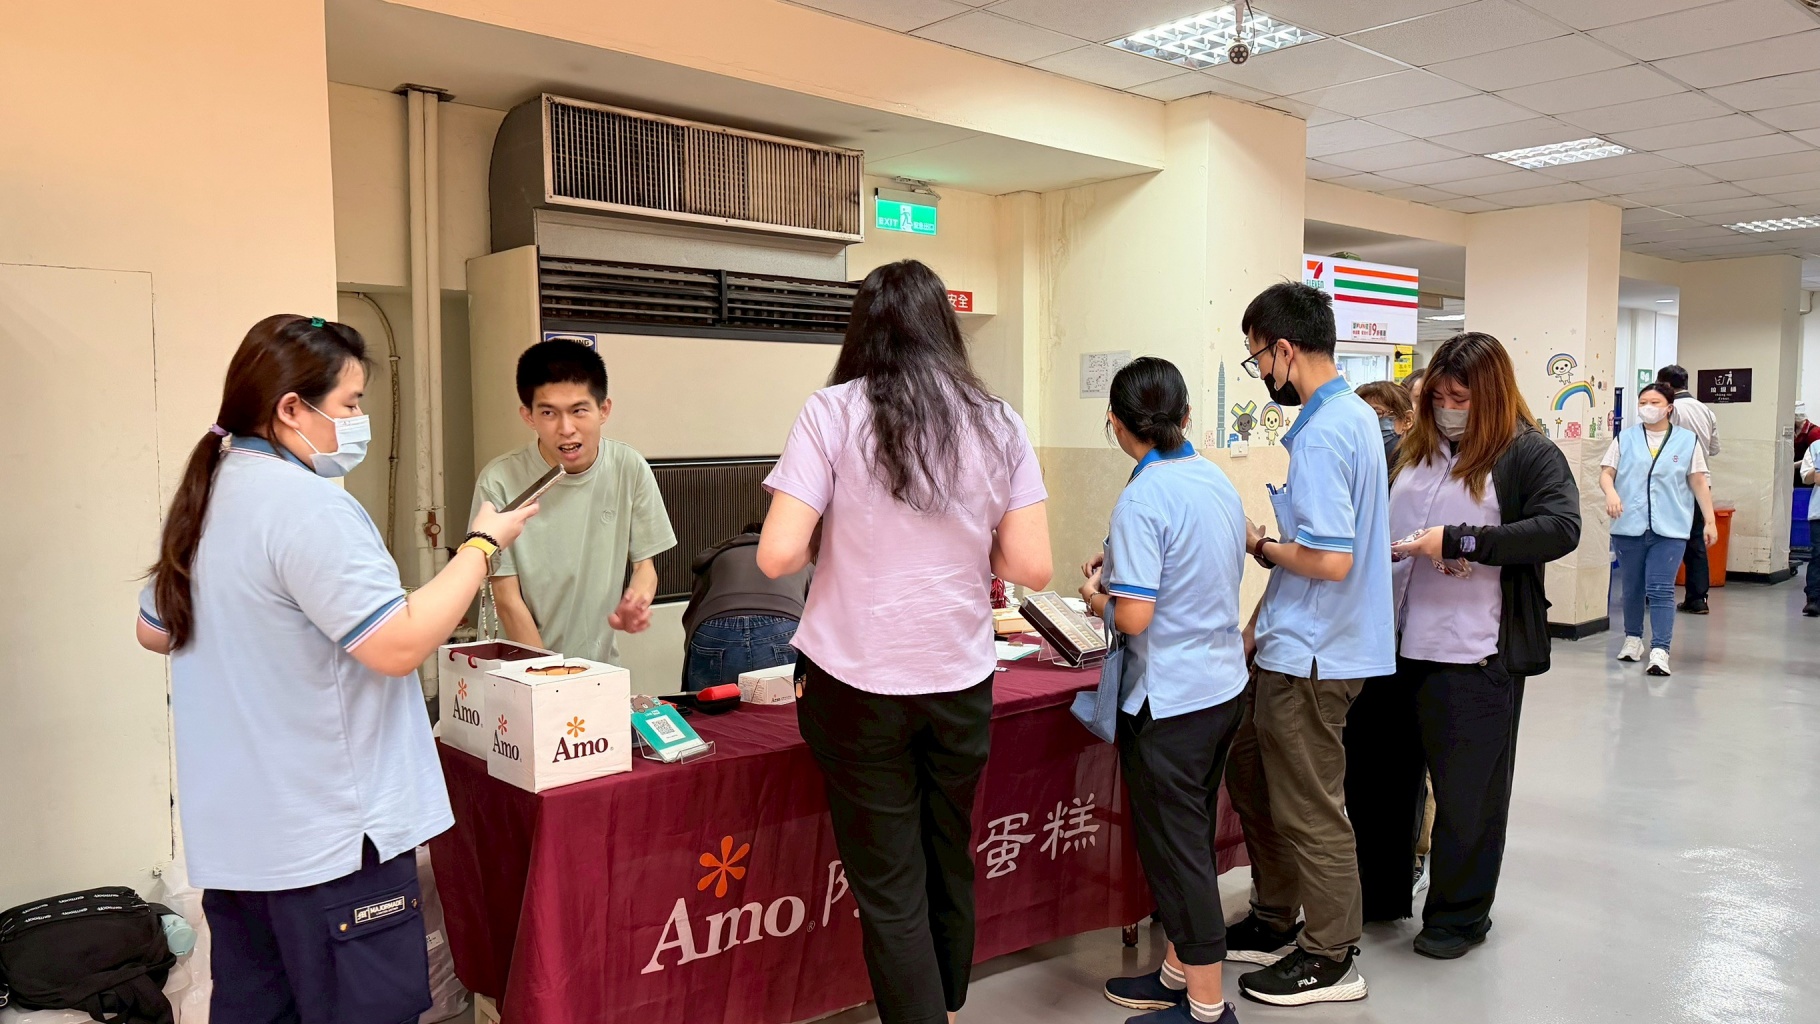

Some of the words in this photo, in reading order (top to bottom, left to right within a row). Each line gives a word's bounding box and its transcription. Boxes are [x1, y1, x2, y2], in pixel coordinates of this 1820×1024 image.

[878, 216, 898, 227] EXIT
[452, 694, 480, 727] Amo
[492, 730, 520, 761] Amo
[552, 736, 609, 763] Amo
[641, 897, 806, 974] Amo
[1297, 976, 1318, 988] FILA
